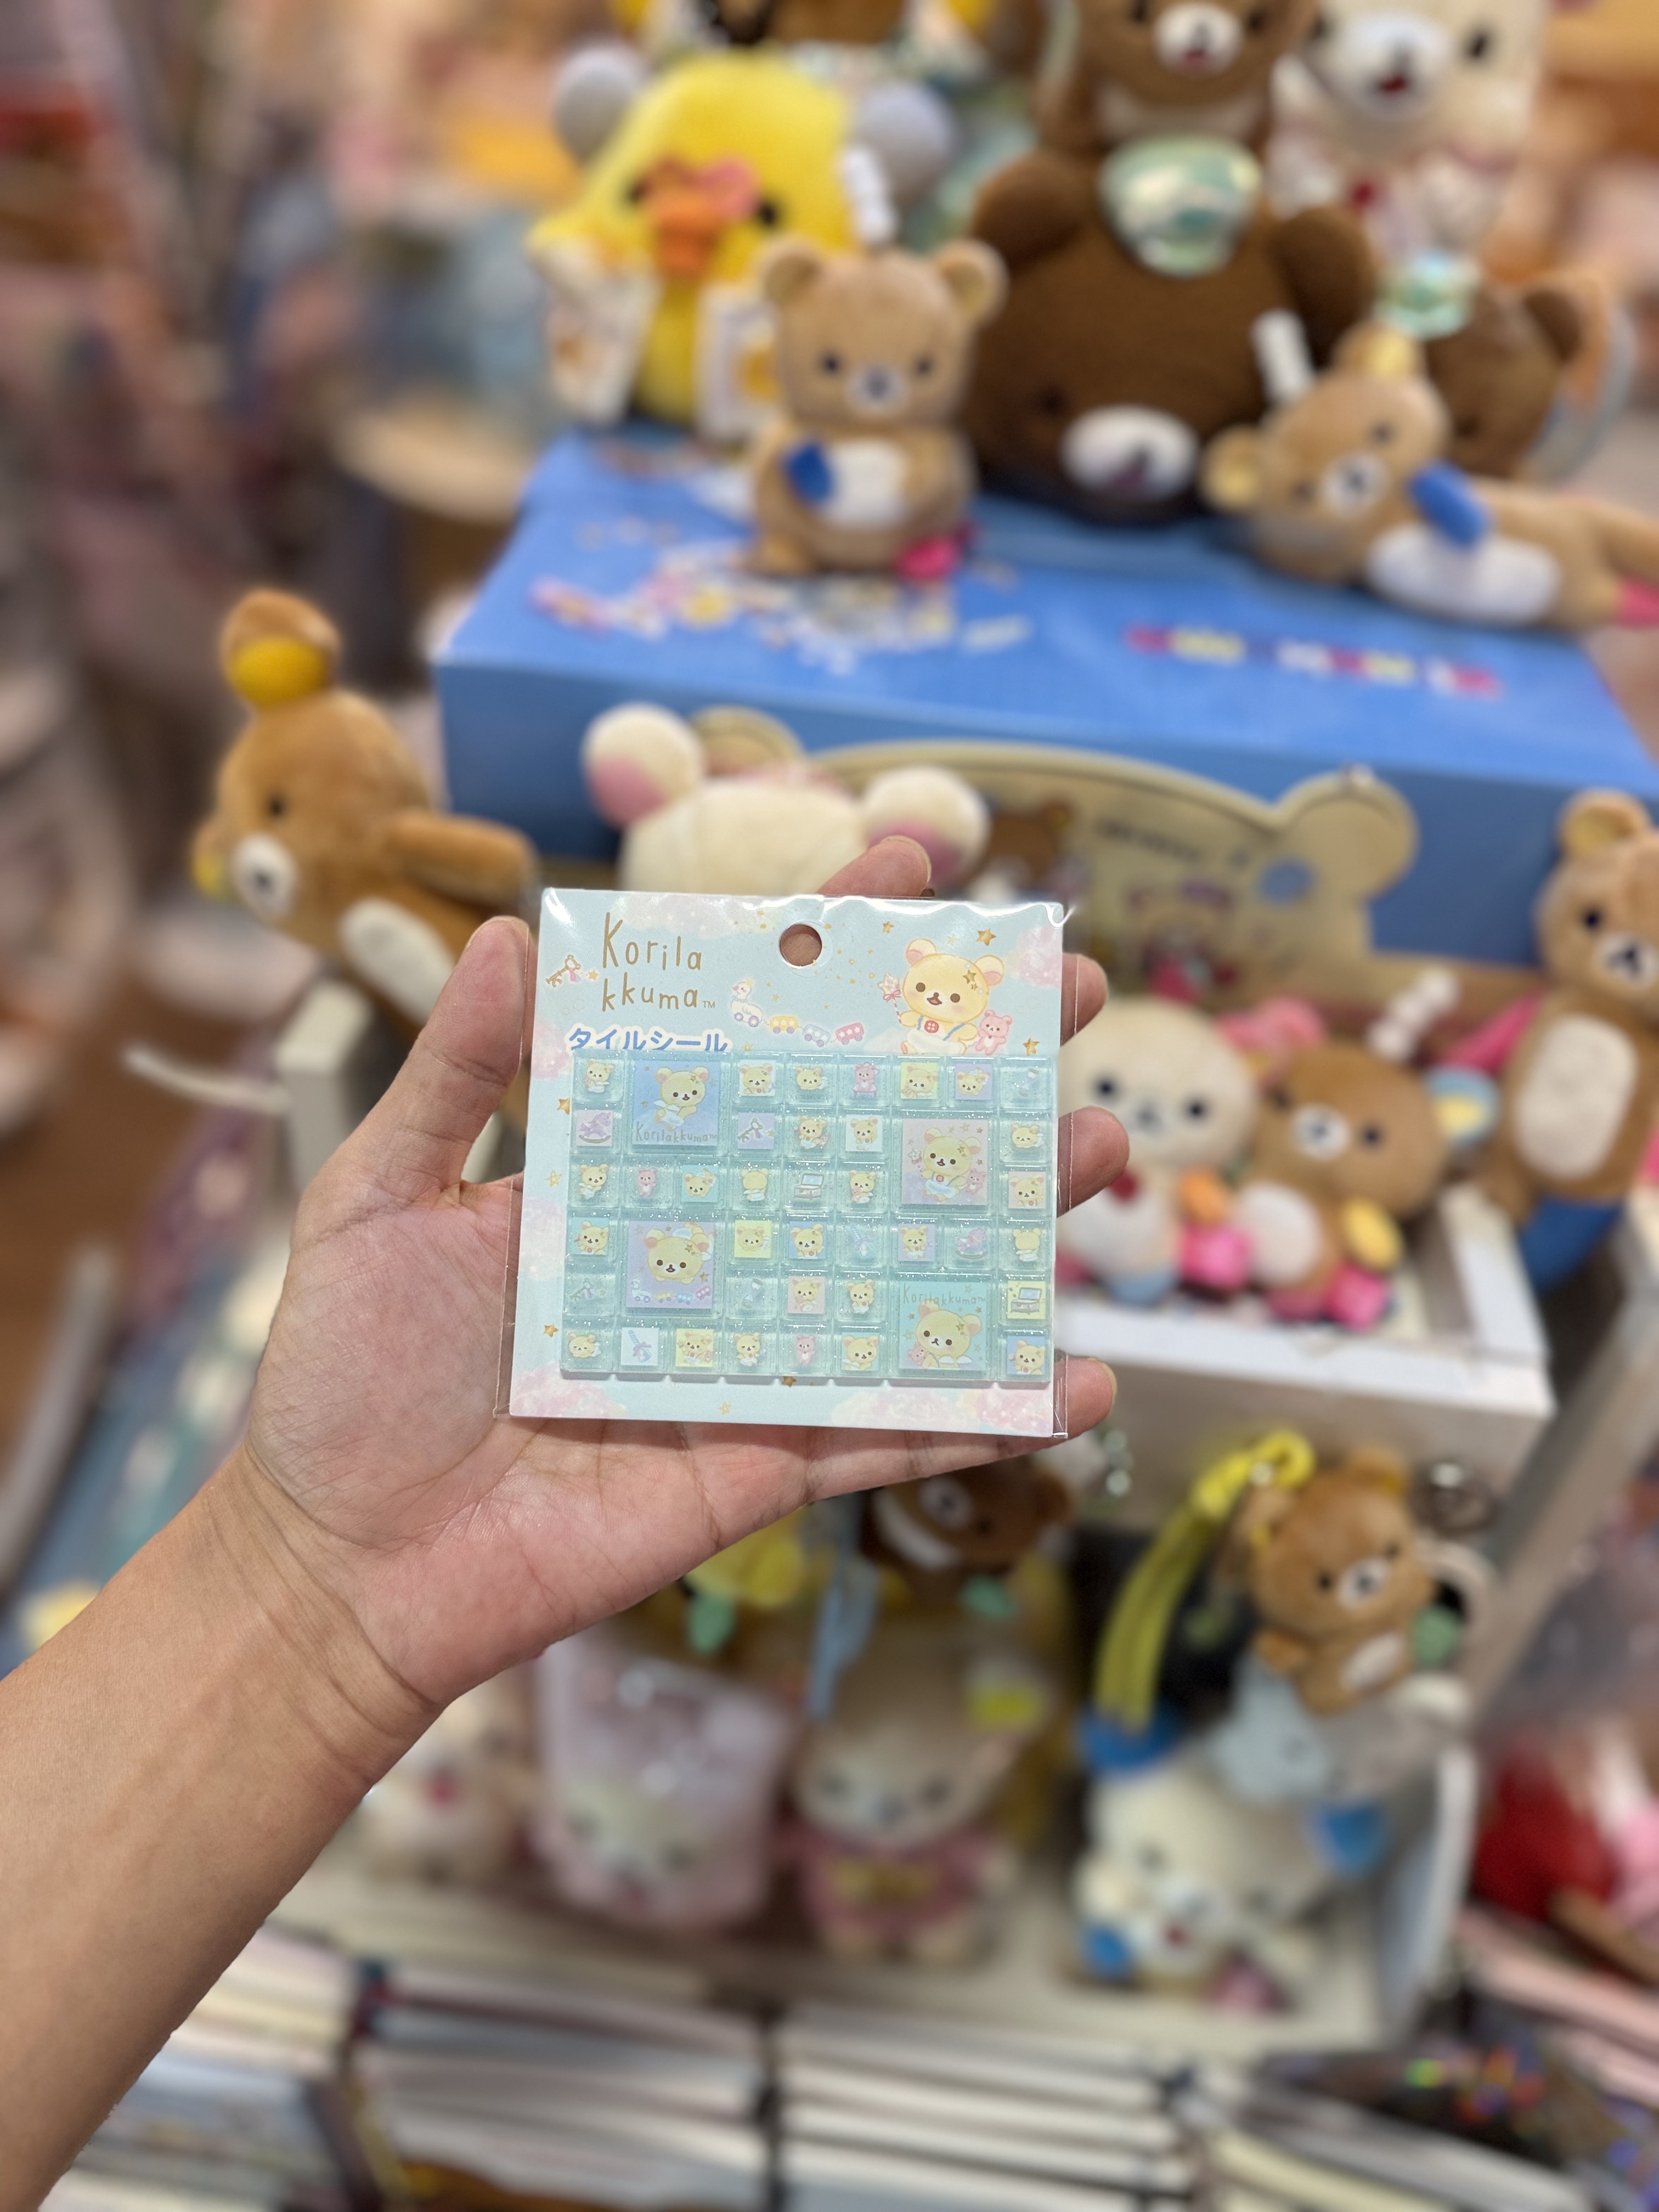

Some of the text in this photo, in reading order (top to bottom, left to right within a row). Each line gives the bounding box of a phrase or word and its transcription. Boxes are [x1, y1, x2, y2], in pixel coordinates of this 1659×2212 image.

[602, 912, 702, 971] Korila
[569, 1028, 728, 1052] タイルシール
